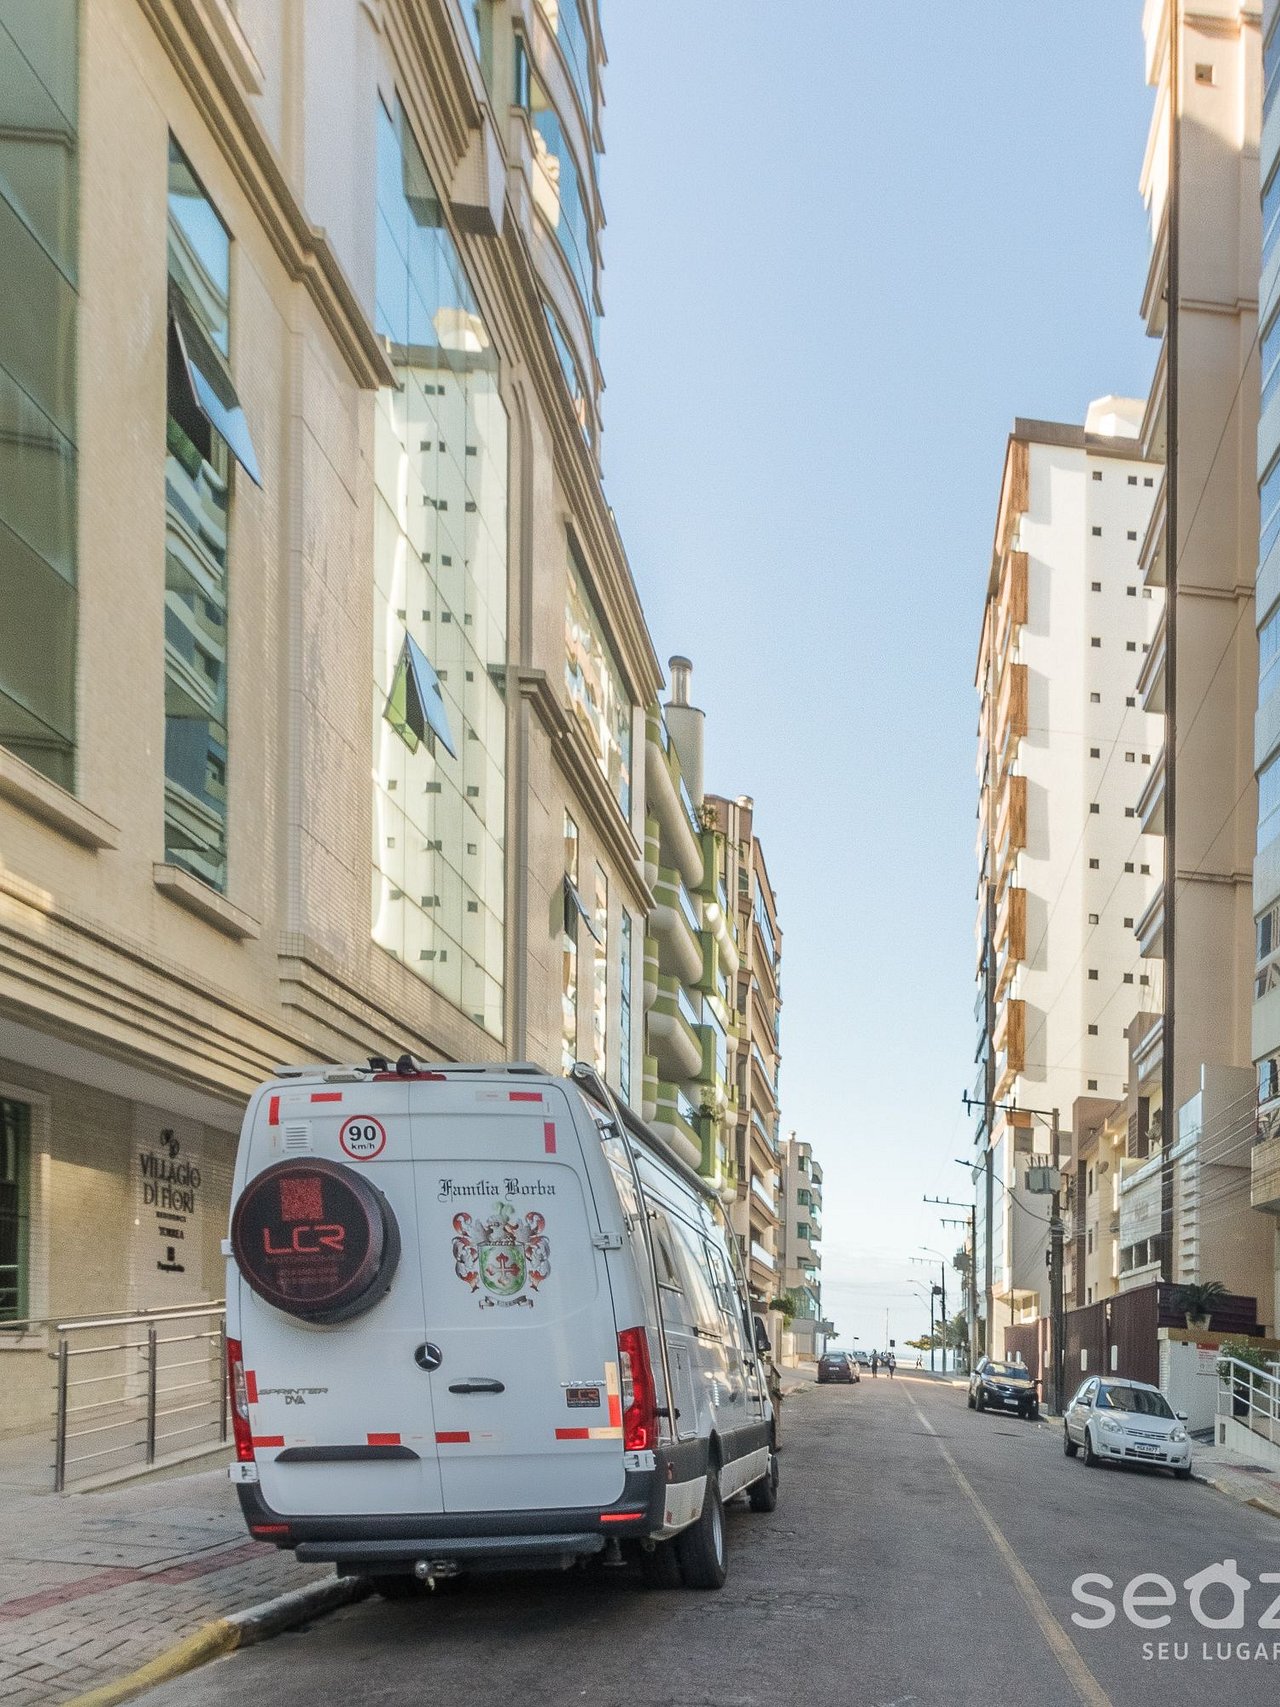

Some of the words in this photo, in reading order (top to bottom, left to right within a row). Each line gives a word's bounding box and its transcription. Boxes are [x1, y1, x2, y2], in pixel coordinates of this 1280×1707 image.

[348, 1125, 377, 1141] 90
[351, 1142, 375, 1150] km/h
[503, 1177, 557, 1202] Borba
[263, 1224, 346, 1254] LCR
[258, 1387, 329, 1396] SPRINTER
